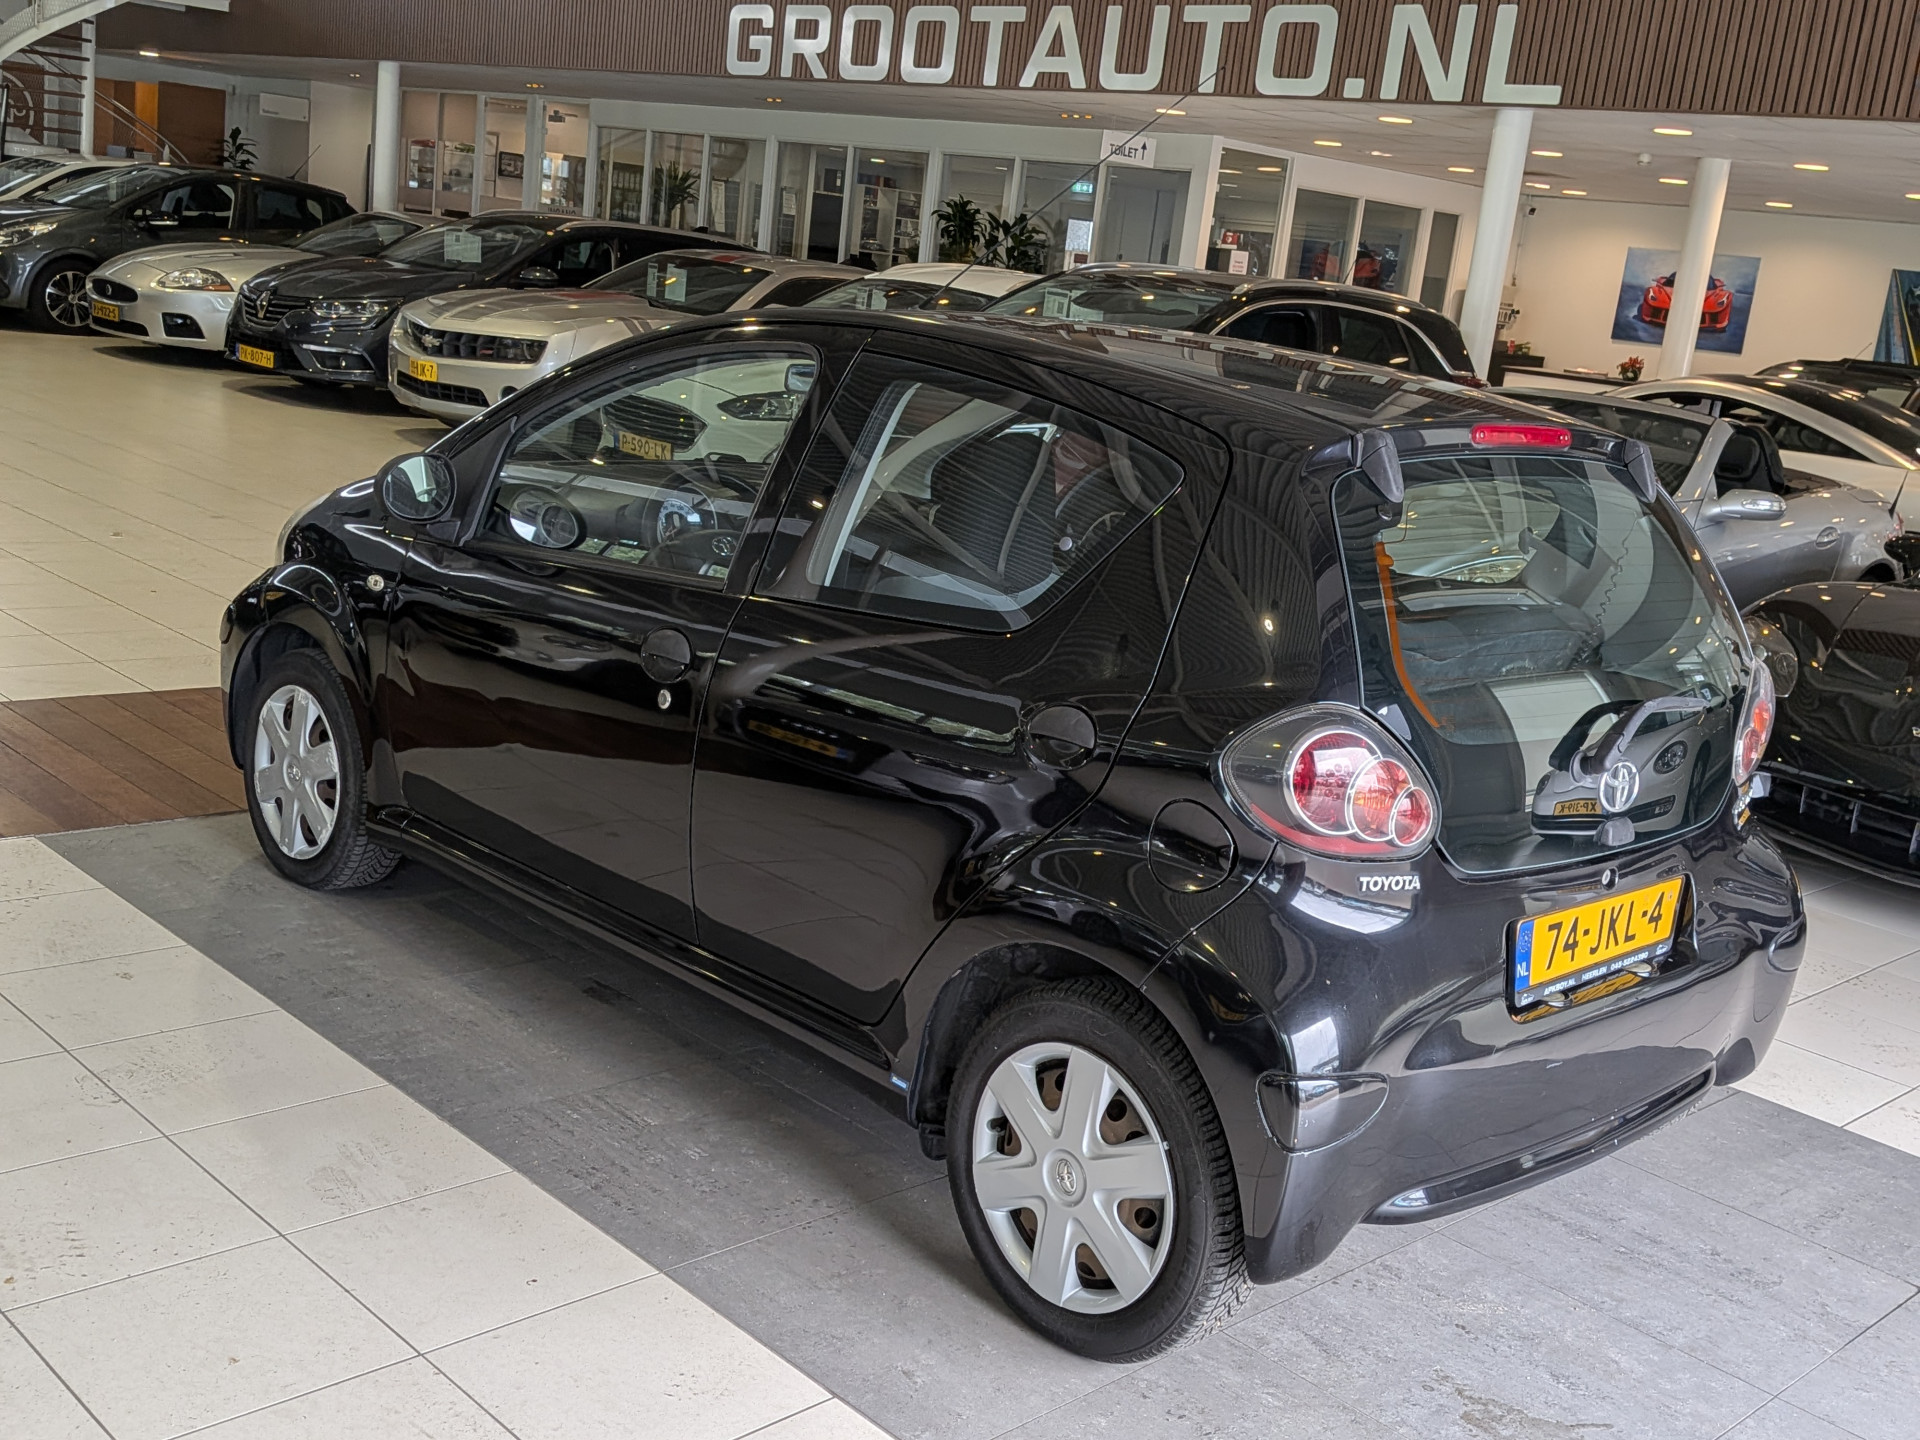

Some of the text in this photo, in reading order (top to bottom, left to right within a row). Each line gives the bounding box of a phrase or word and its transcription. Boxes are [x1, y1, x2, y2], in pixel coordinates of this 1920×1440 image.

[726, 3, 1563, 106] GROOTAUTO.NL
[1109, 143, 1139, 159] TOILET
[621, 433, 667, 460] P-590-LK
[1359, 875, 1421, 892] TOYOTA
[1516, 891, 1666, 979] NL 74-JKL-4
[1581, 965, 1608, 982] HEERLEN
